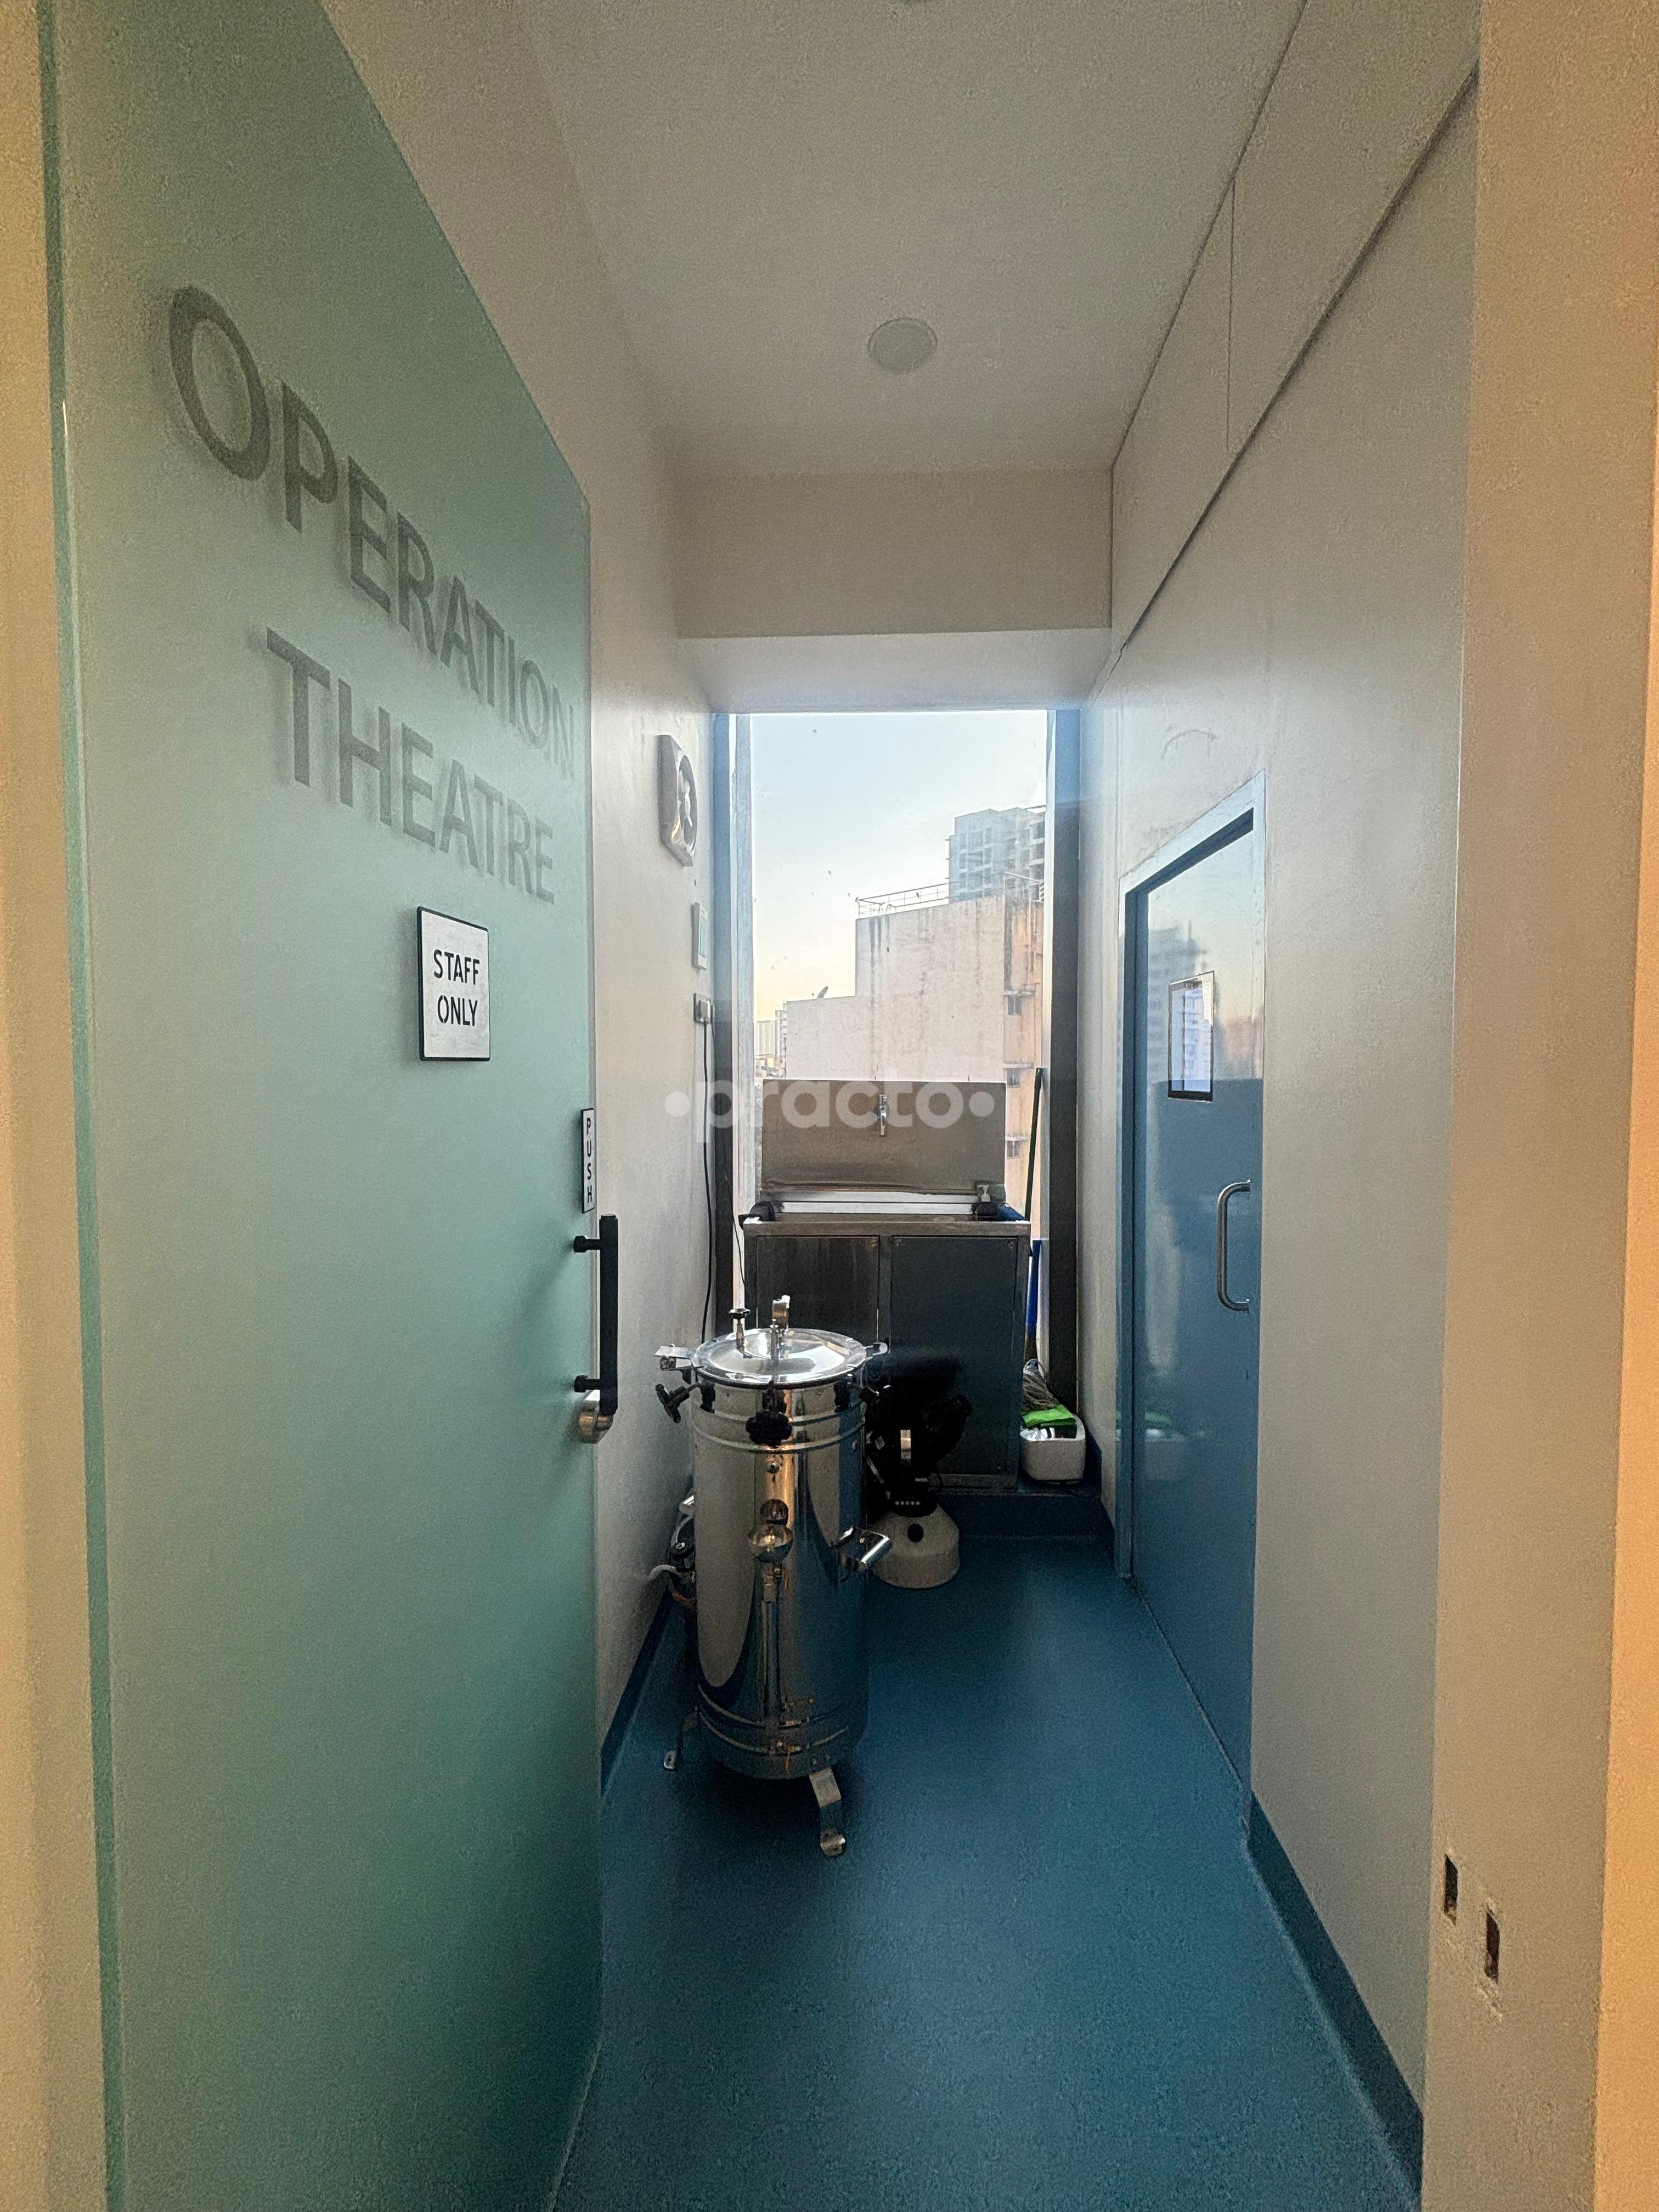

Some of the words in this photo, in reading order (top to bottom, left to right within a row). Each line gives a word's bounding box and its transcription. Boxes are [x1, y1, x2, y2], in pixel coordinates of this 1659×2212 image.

[170, 285, 574, 779] OPERATION
[267, 627, 555, 904] THEATRE
[433, 949, 480, 985] STAFF
[437, 995, 478, 1026] ONLY
